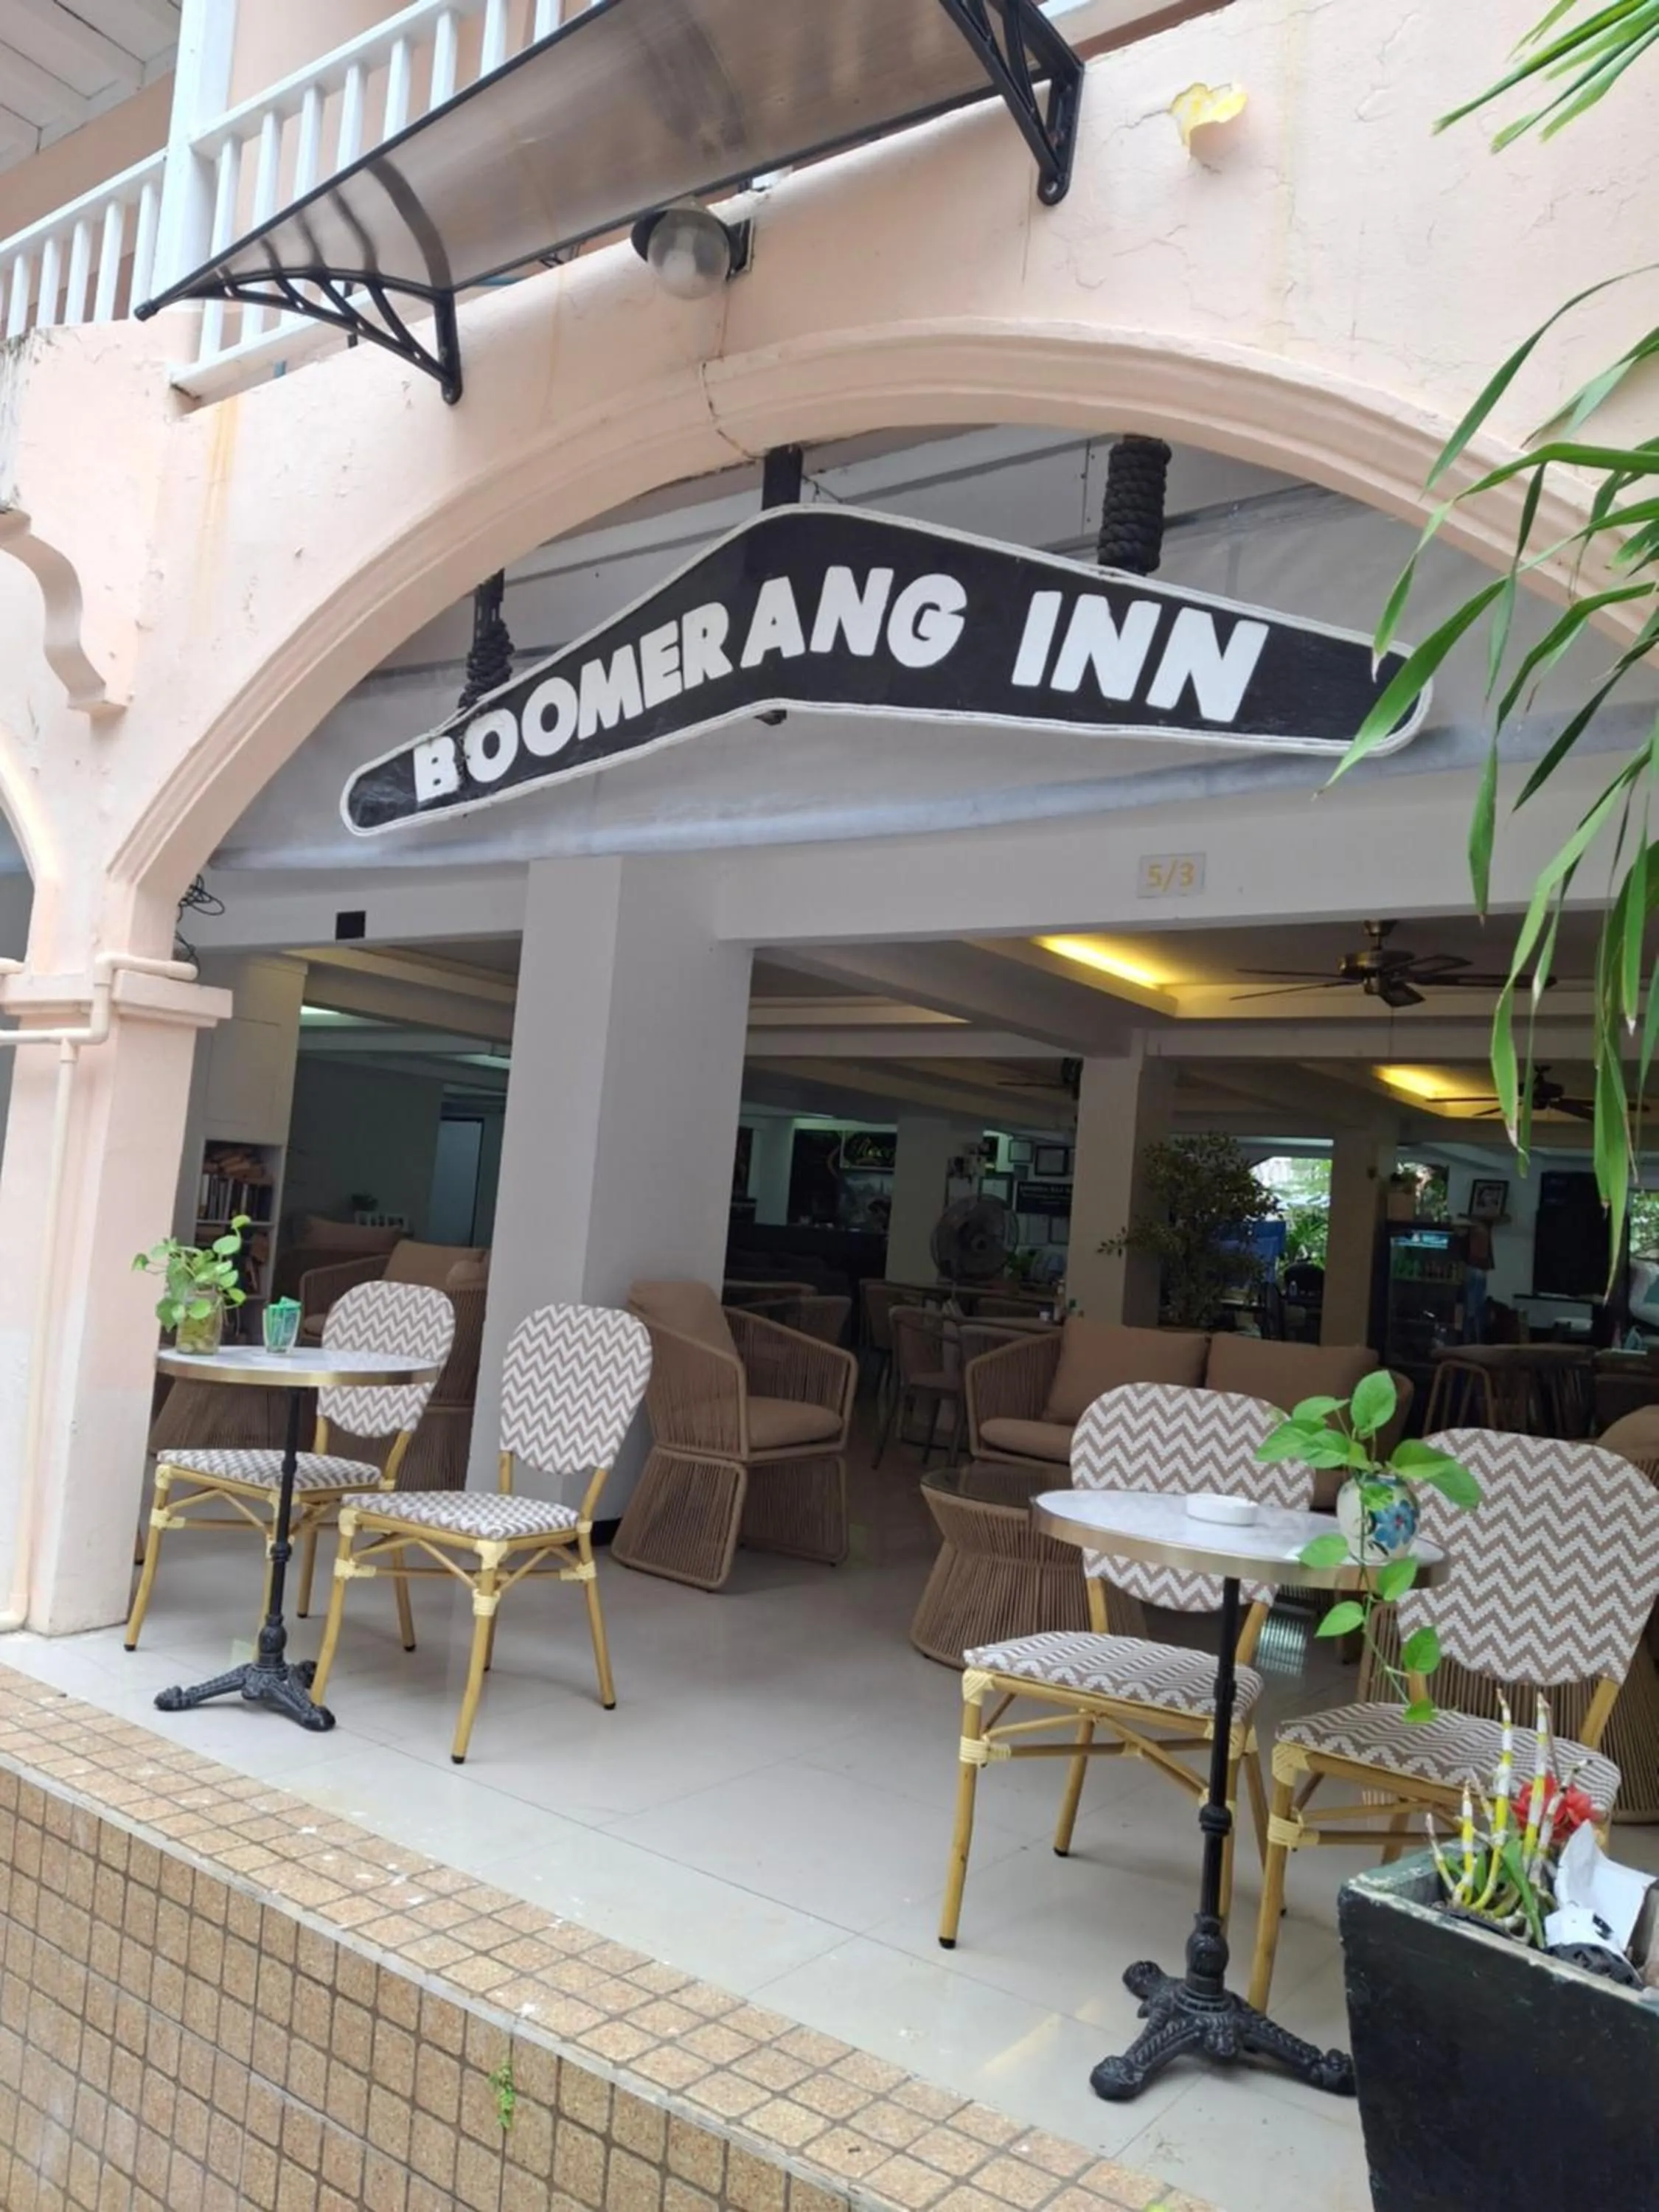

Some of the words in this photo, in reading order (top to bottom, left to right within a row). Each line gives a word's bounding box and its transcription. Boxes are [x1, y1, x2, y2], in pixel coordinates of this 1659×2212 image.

[414, 565, 967, 803] BOOMERANG
[1011, 591, 1269, 723] INN
[1147, 858, 1195, 892] 5/3
